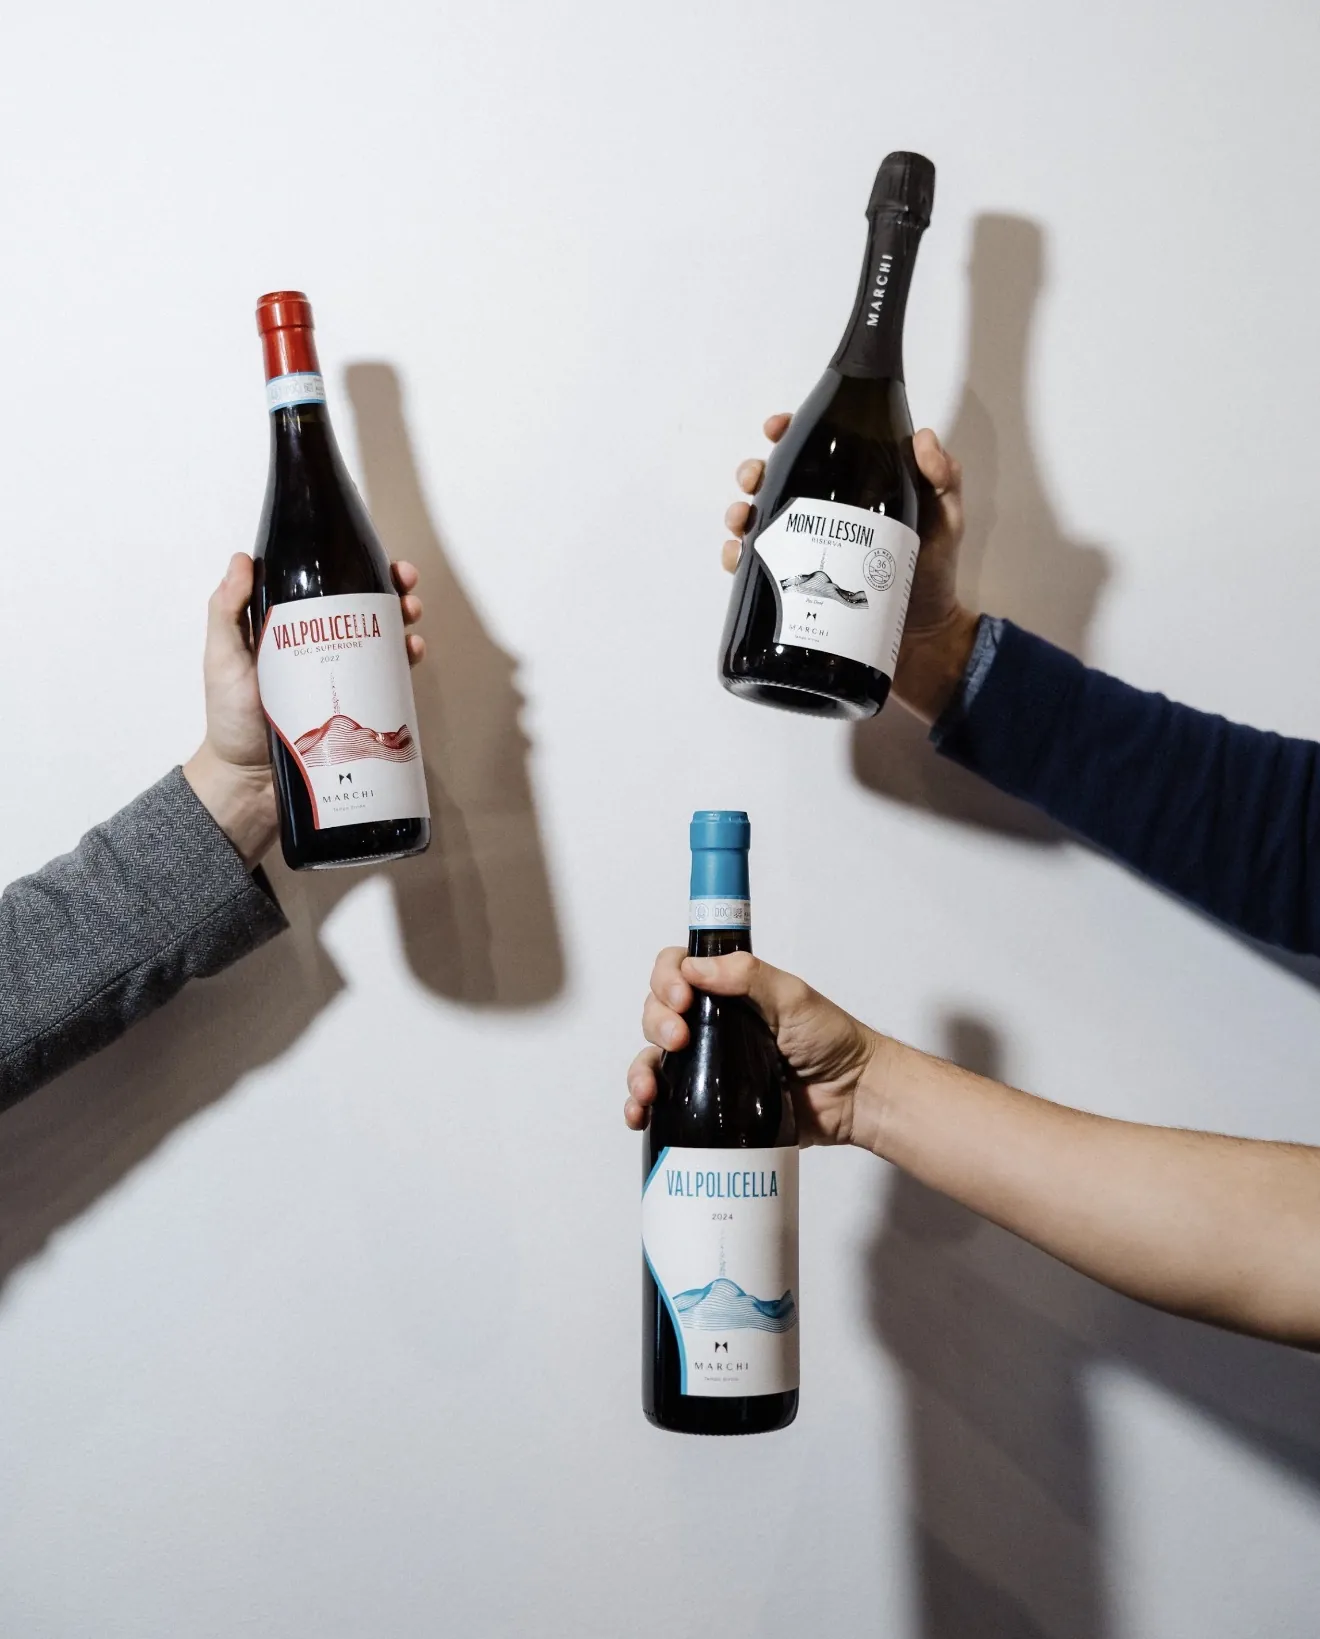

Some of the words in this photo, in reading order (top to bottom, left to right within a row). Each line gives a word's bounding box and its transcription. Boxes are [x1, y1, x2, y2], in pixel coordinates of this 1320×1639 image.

[866, 254, 893, 327] MARCHI
[786, 513, 827, 536] MONTI
[828, 518, 875, 548] LESSINI
[811, 537, 842, 548] RISERVA
[876, 559, 887, 569] 36
[273, 613, 382, 650] VALPOLICELLA
[789, 624, 829, 637] MARCHI
[293, 648, 312, 657] DOC
[315, 641, 363, 653] SUPERIORE
[320, 655, 340, 664] 2022
[322, 789, 374, 803] MARCHI
[666, 1170, 778, 1198] VALPOLICELLA
[712, 1213, 734, 1221] 2024
[694, 1362, 749, 1371] MARCHI
